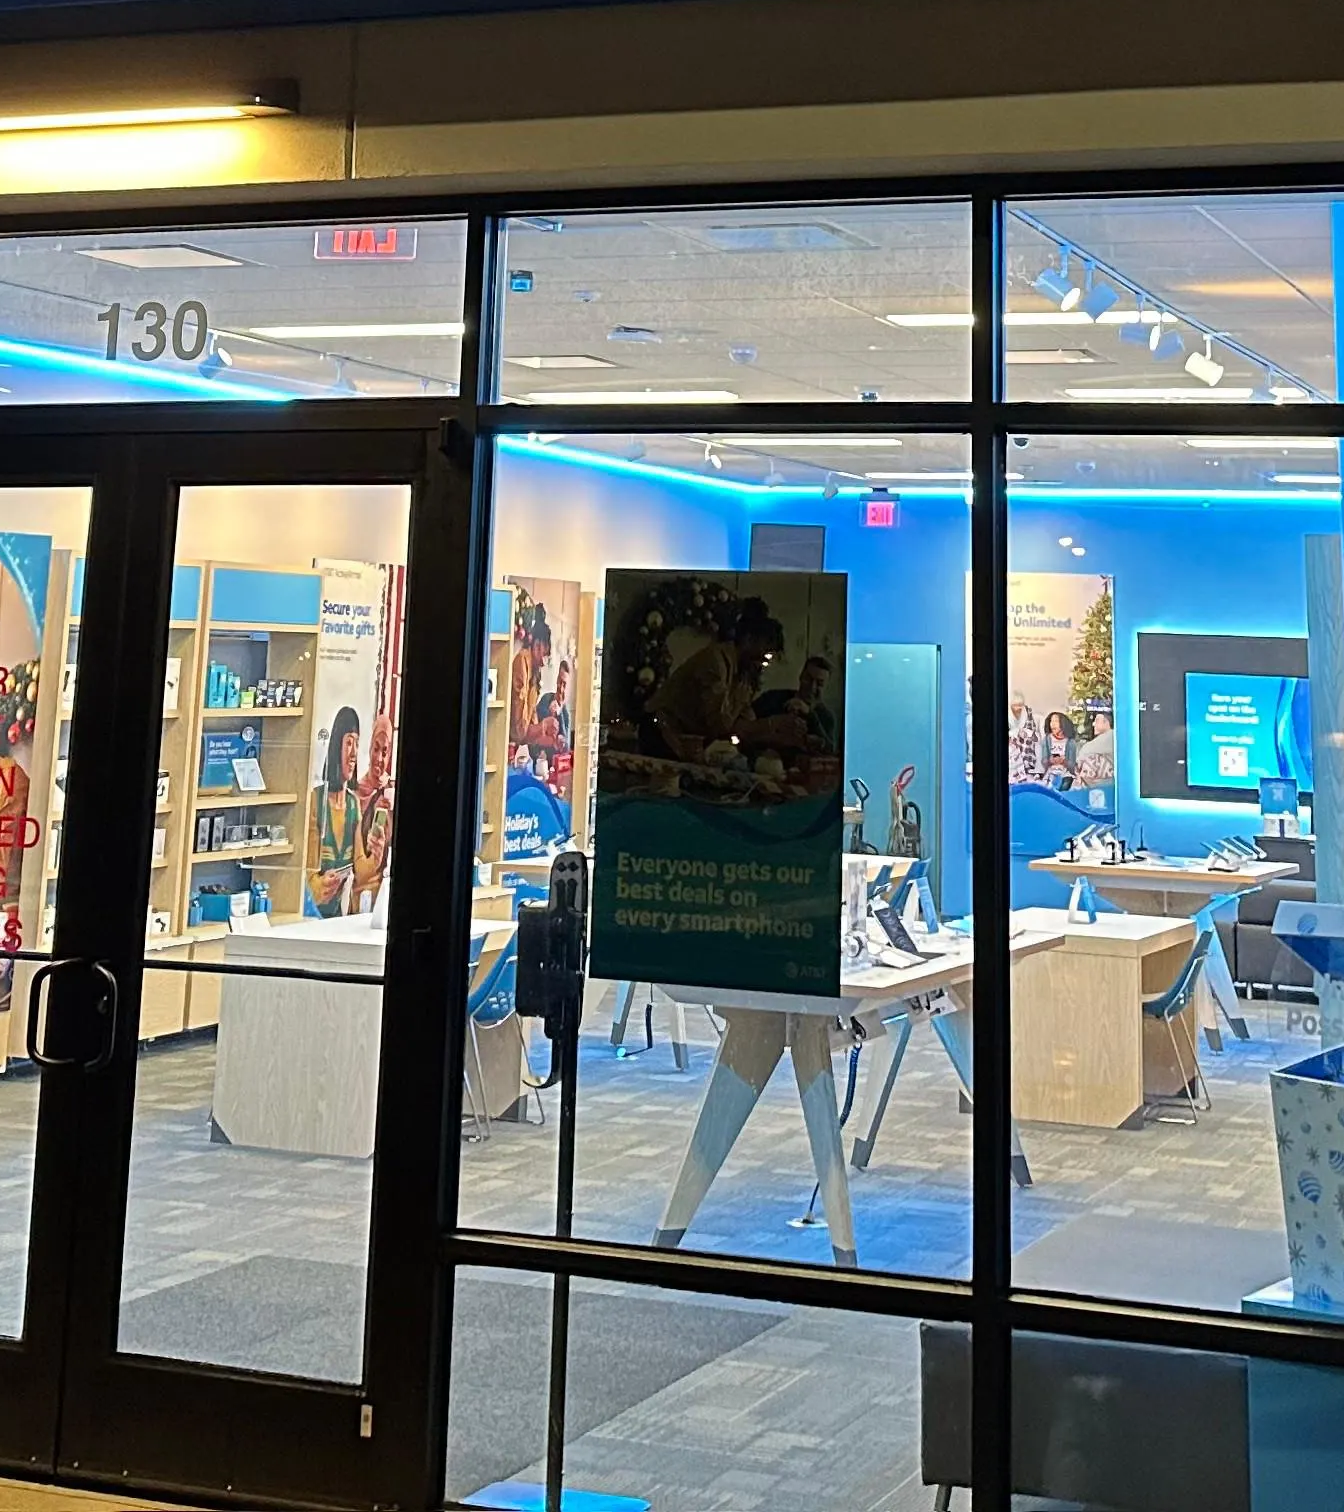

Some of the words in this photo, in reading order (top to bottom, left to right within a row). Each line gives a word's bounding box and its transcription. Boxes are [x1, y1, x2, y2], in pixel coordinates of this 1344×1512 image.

[97, 300, 208, 362] 130
[322, 600, 350, 615] Secure
[352, 605, 372, 620] your
[1026, 602, 1046, 614] the
[321, 618, 354, 635] favorite
[355, 621, 375, 639] gifts
[1013, 616, 1072, 628] Unlimited
[505, 813, 539, 834] Holiday's
[504, 835, 521, 852] best
[522, 832, 542, 850] deals
[617, 851, 717, 880] Everyone
[722, 861, 772, 885] gets
[776, 866, 814, 885] our
[616, 876, 664, 900] best
[668, 880, 725, 906] deals
[730, 890, 758, 908] on
[615, 907, 676, 934] every
[678, 912, 814, 940] smartphone
[798, 965, 828, 979] AT&T
